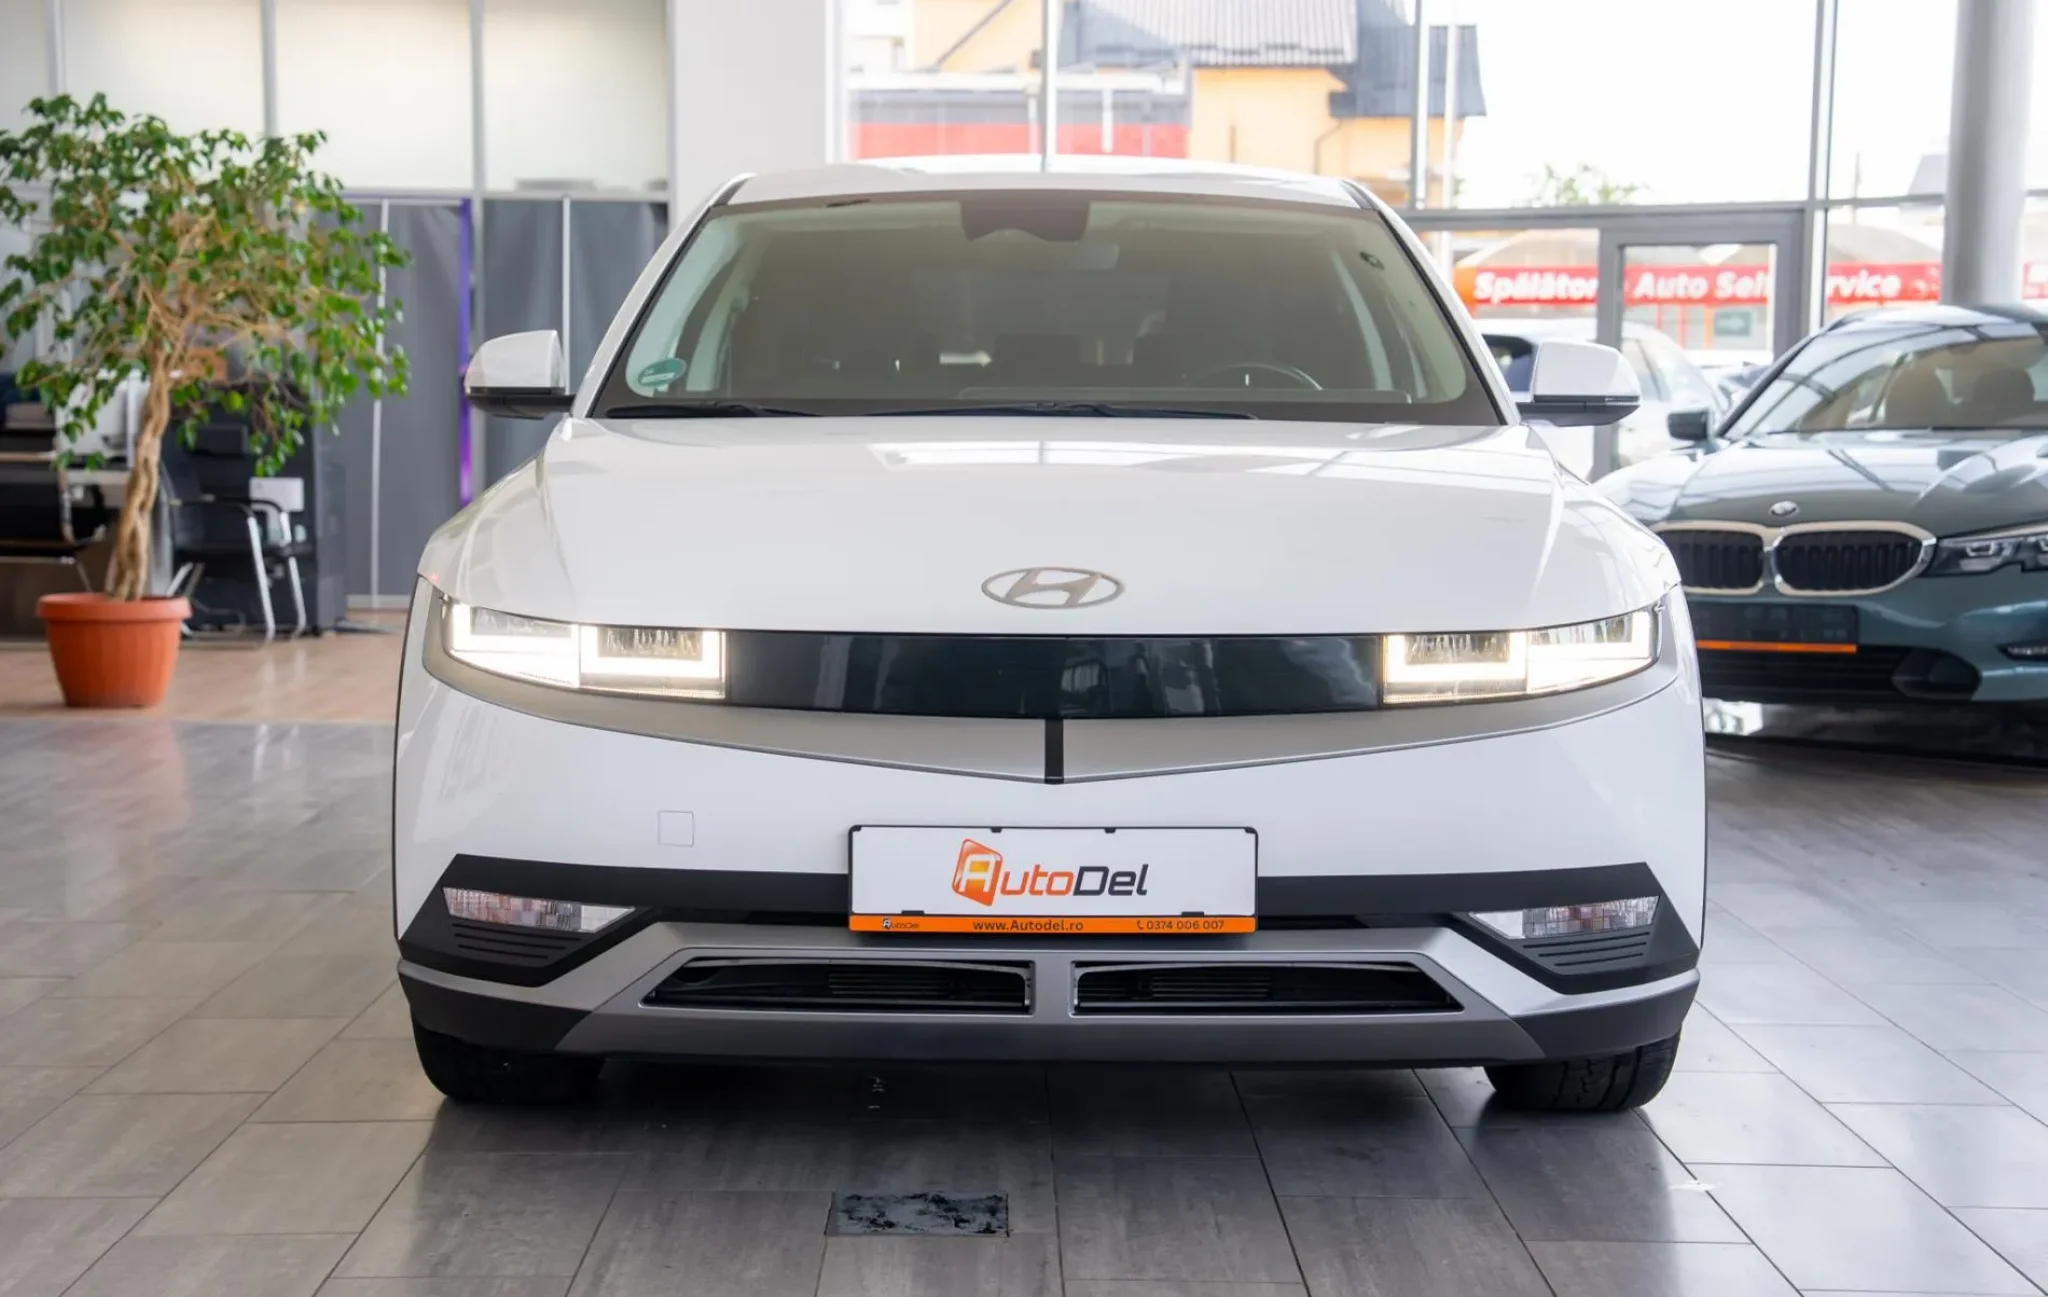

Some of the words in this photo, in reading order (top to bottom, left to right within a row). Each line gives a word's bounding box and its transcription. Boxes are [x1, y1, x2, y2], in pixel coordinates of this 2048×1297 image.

[1473, 271, 1599, 304] Spălător
[1633, 271, 1708, 298] Auto
[1827, 269, 1901, 298] rvice
[955, 851, 1149, 898] AutoDel
[973, 919, 1084, 932] www.Autodel.ro
[1146, 919, 1173, 930] 0374
[1176, 919, 1200, 930] 006
[1203, 919, 1224, 930] 007
